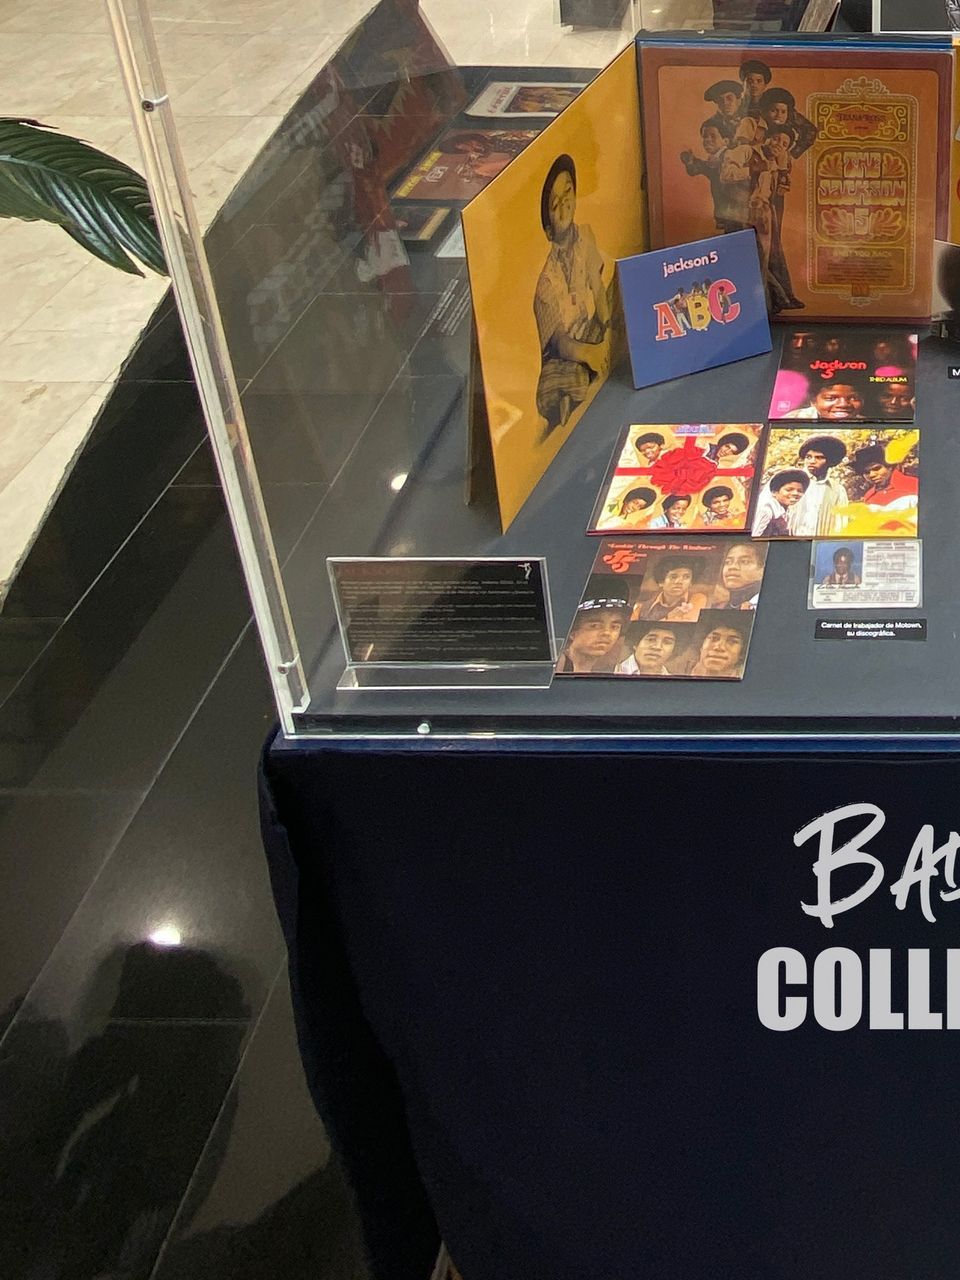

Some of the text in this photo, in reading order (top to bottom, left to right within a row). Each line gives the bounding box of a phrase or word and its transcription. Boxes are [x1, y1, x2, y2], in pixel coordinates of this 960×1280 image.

[653, 278, 741, 341] ABC
[821, 621, 843, 629] Carnet
[853, 622, 884, 631] trabajador
